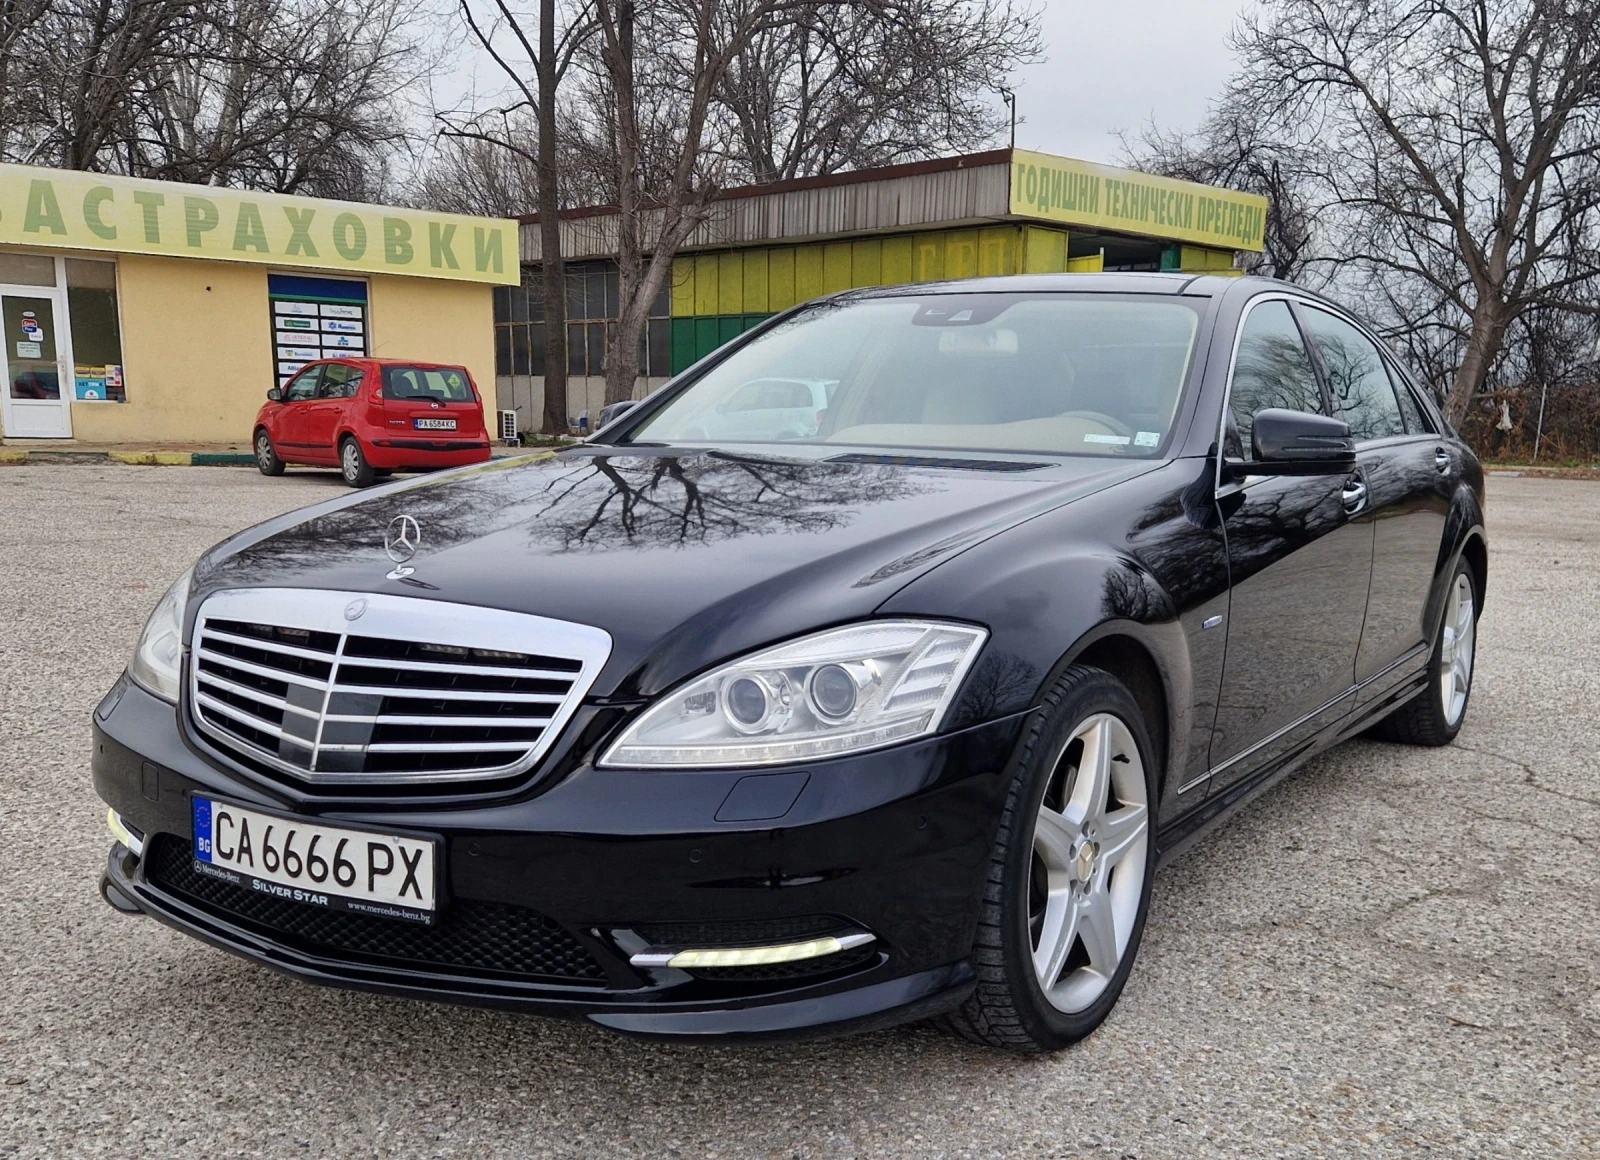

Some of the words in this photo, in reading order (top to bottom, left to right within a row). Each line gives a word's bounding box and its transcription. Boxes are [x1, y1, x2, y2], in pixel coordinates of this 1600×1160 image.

[1016, 163, 1100, 214] ГОДИШНИ
[1105, 178, 1194, 229] ТЕХНИЧЕСКИ
[1197, 195, 1262, 245] ПРЕГЛЕДИ
[0, 179, 504, 275] АСТРАХОВКИ
[198, 837, 211, 853] BG
[202, 864, 240, 883] Mercedes-Benz
[252, 879, 291, 898] SILVER
[293, 889, 328, 905] STAR
[347, 902, 431, 925] www.mercedes-benz.bg
